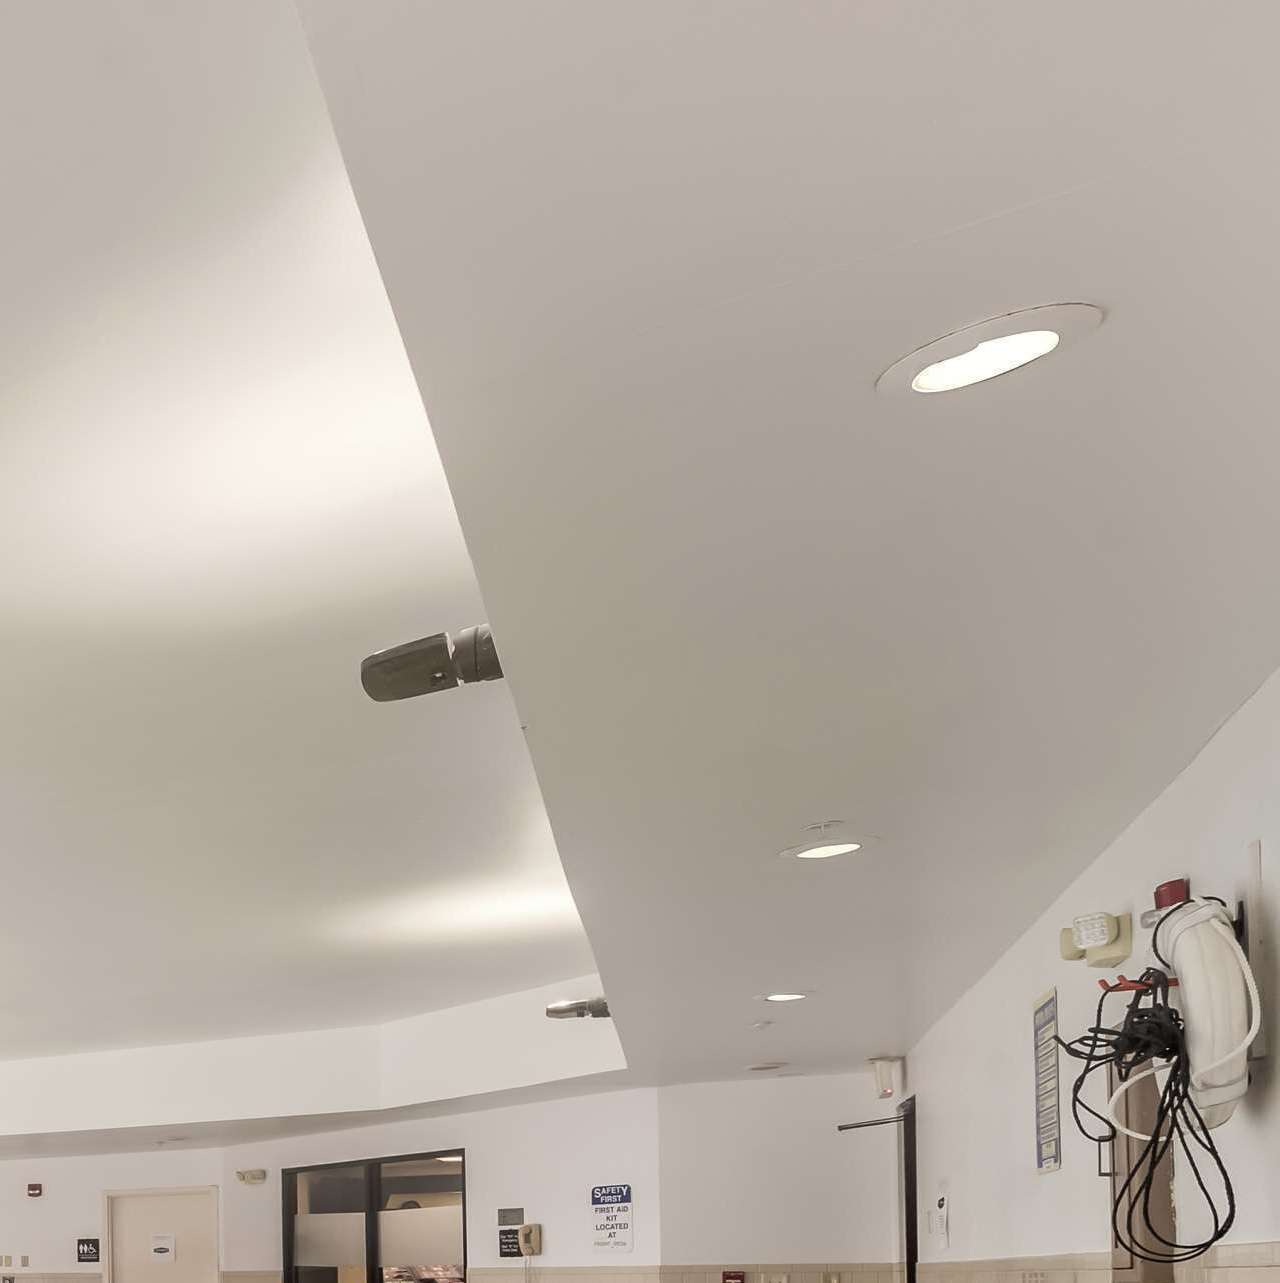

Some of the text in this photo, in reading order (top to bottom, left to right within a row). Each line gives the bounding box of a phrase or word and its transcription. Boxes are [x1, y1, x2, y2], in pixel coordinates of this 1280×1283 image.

[594, 1186, 628, 1198] SAFETY
[601, 1195, 622, 1203] FIRST
[595, 1206, 614, 1214] FIRST
[596, 1223, 628, 1231] LOCATED
